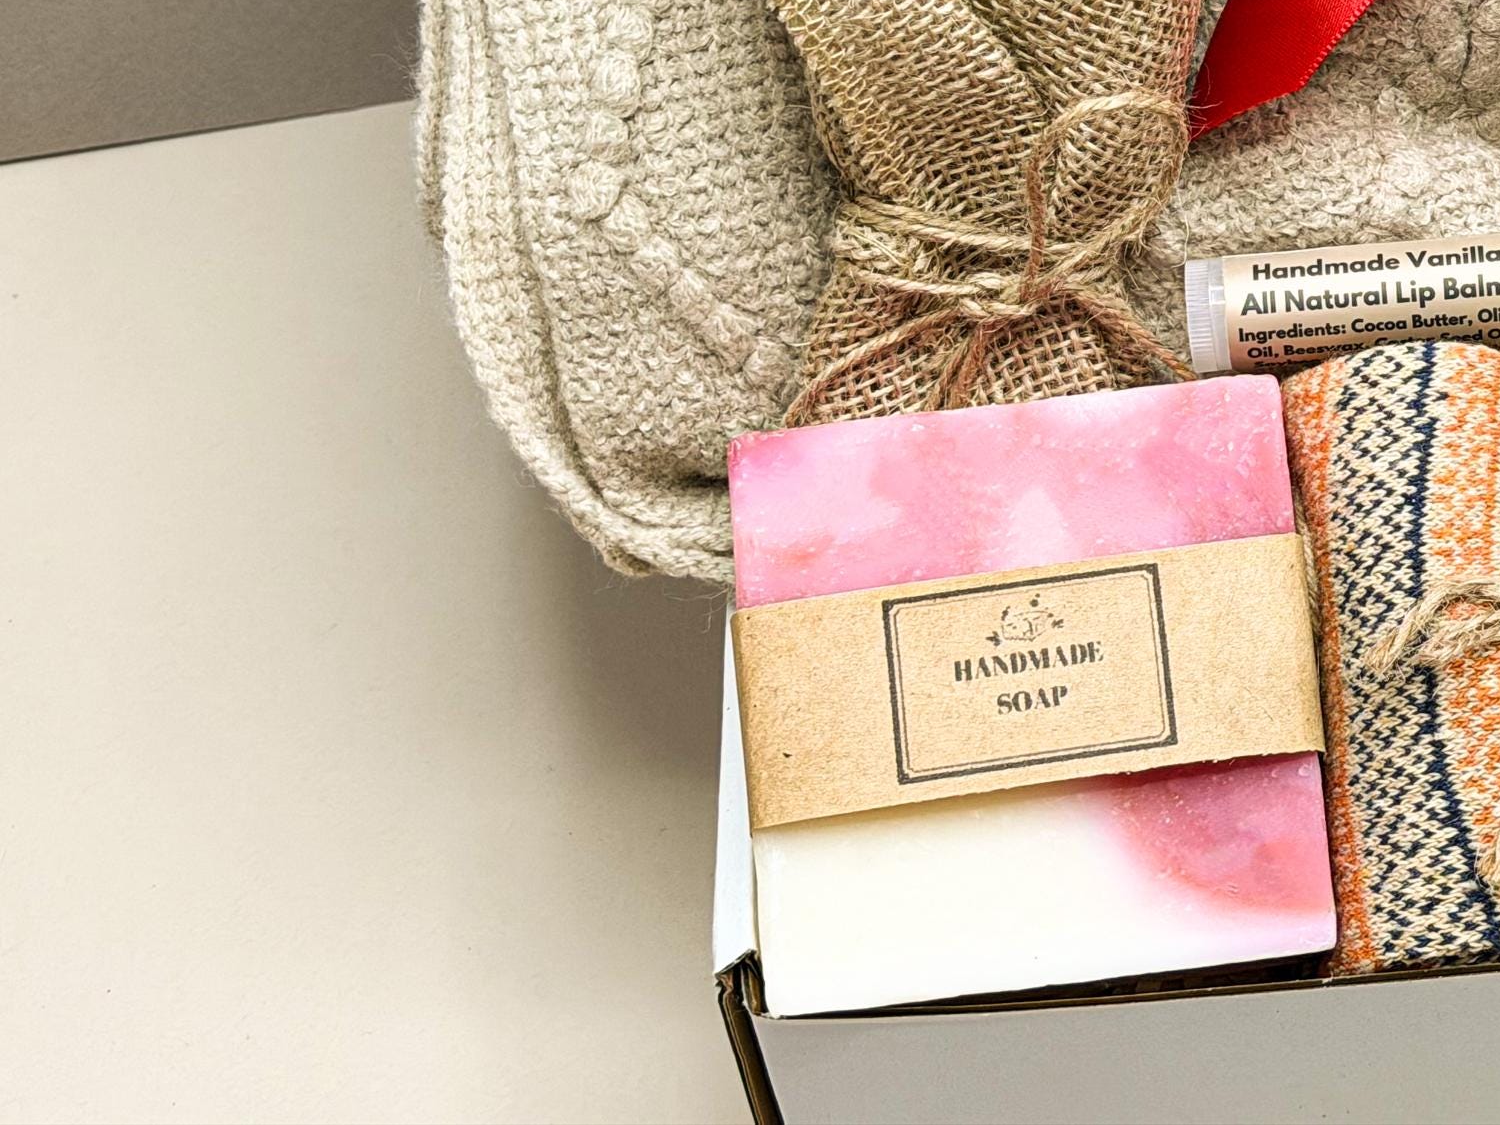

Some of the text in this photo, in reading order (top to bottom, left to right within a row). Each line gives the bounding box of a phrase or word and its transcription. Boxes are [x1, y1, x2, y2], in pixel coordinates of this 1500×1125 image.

[1252, 253, 1400, 281] Handmade
[1241, 292, 1276, 316] All
[1284, 281, 1388, 312] Natural
[1395, 279, 1435, 308] Lip
[1239, 324, 1346, 344] Ingredients:
[1351, 319, 1407, 333] Cocoa
[1412, 313, 1473, 328] Butter,
[954, 641, 1104, 682] HANDMADE
[997, 685, 1068, 715] SOAP
